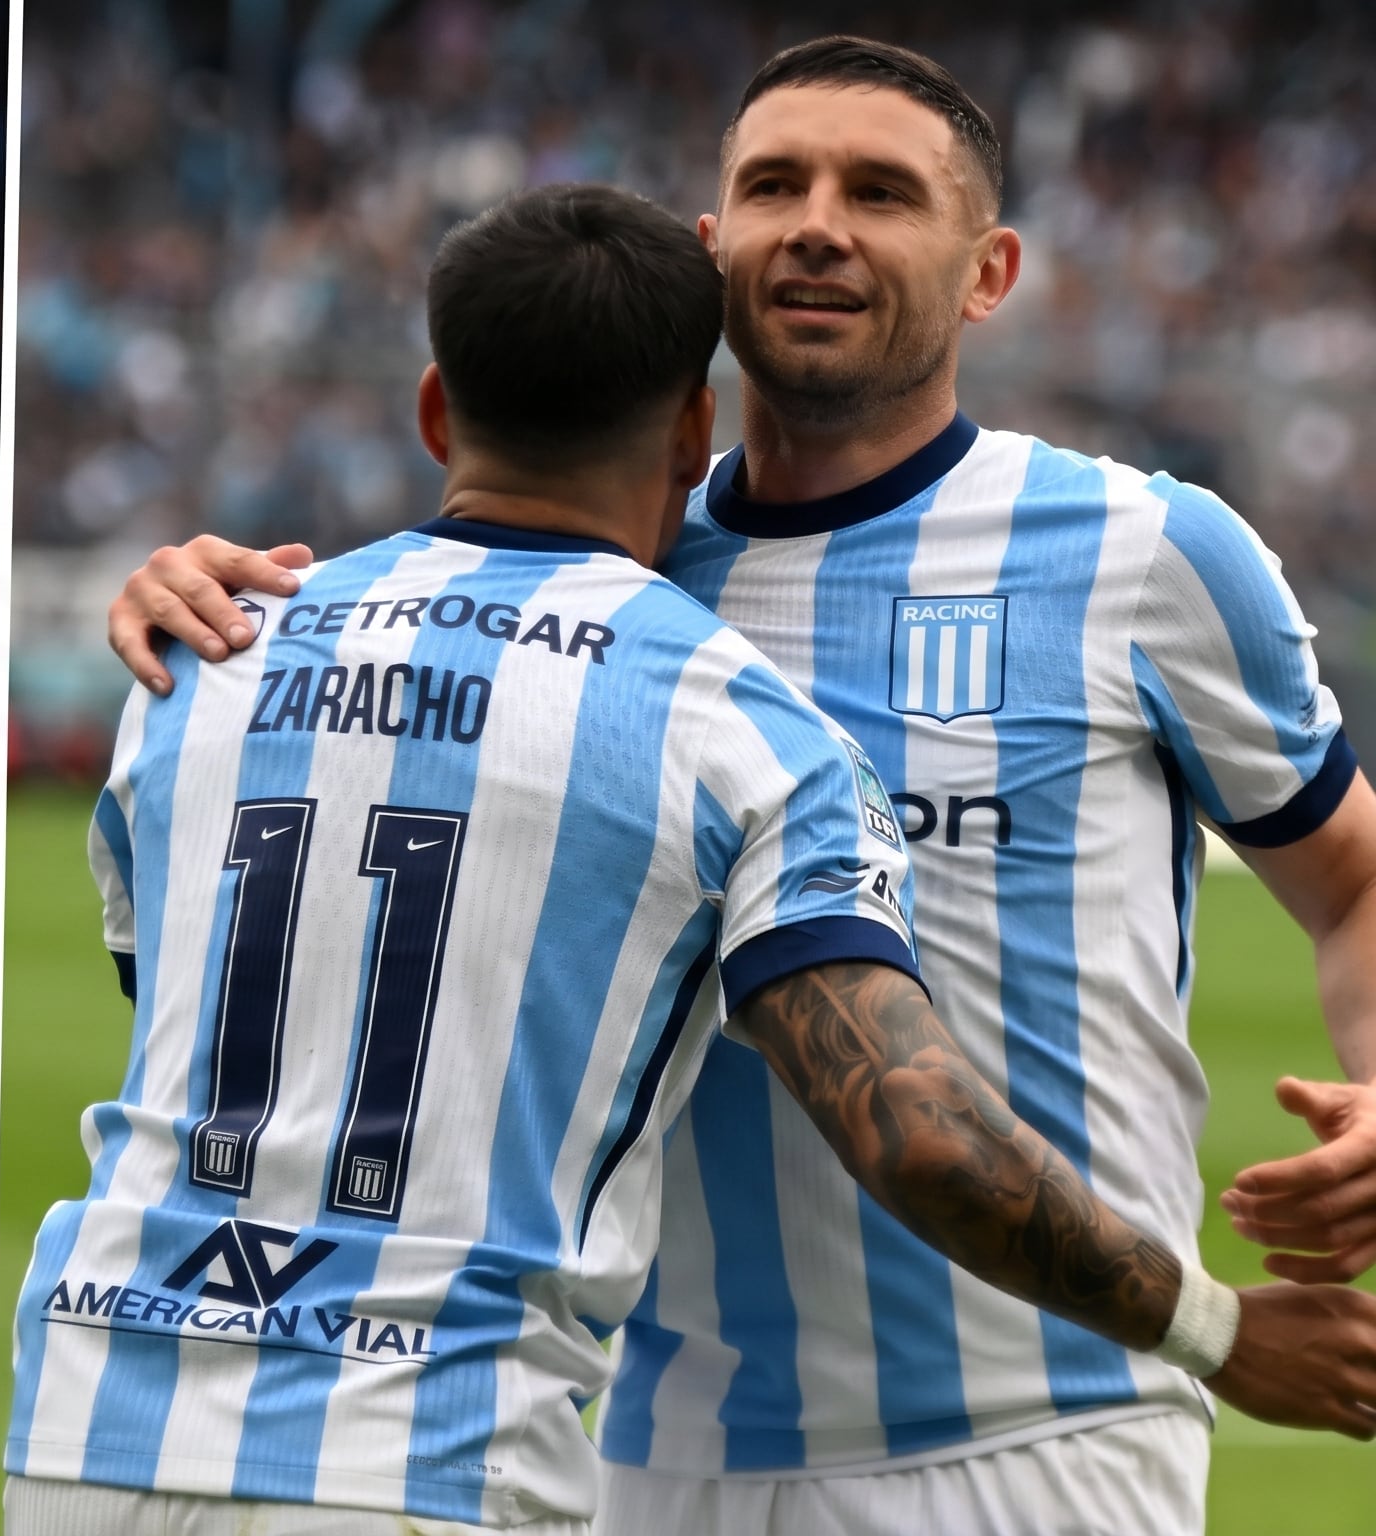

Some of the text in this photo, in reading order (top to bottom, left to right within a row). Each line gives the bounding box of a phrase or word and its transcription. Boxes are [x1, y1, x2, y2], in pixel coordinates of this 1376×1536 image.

[278, 594, 616, 666] CETROGAR
[902, 603, 998, 622] RACING
[246, 662, 493, 745] ZARACHO
[890, 792, 1012, 848] on
[188, 797, 470, 1224] 11
[41, 1278, 438, 1357] AMERICAN VIAL
